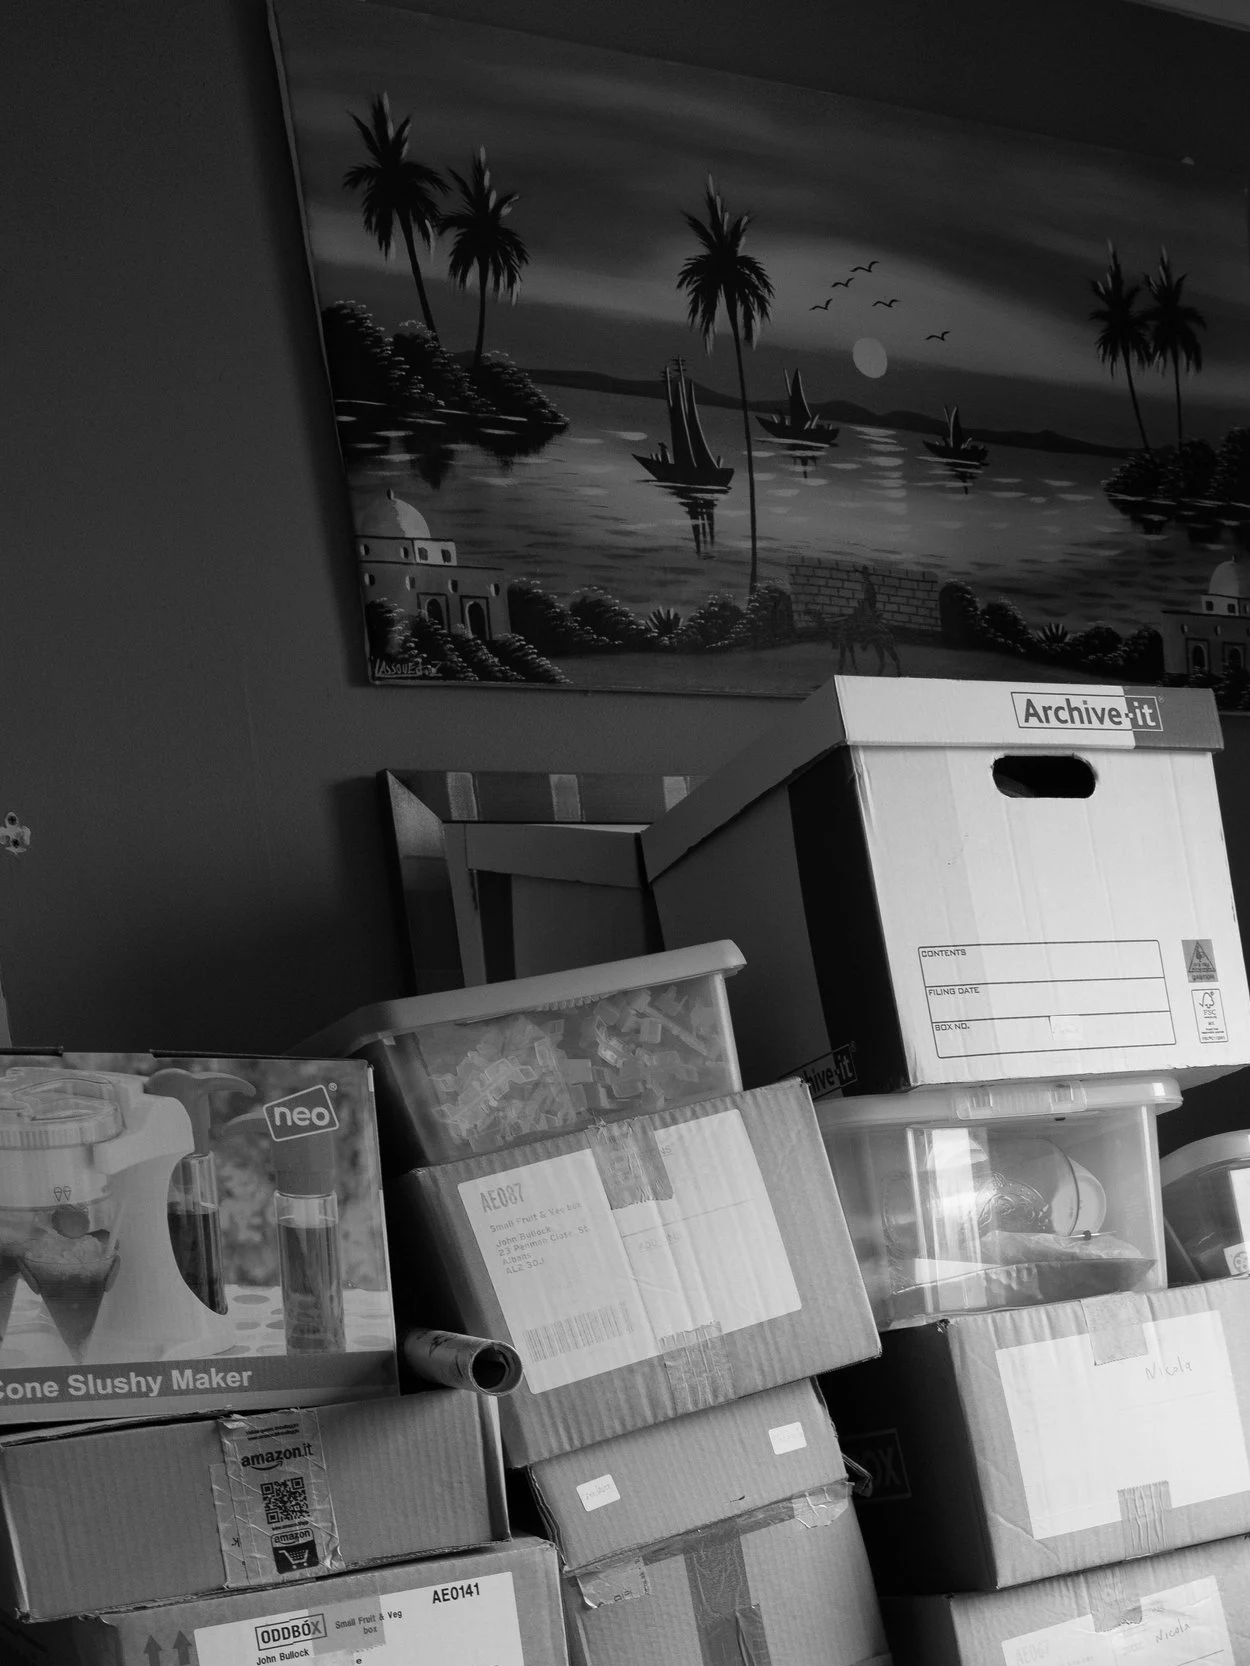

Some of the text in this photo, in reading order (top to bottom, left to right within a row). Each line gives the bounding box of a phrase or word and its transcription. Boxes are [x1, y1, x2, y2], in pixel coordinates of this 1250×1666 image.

[1024, 698, 1156, 726] Archive-it
[921, 949, 967, 958] CONTENTS
[928, 986, 980, 996] FILING DATE
[935, 1022, 971, 1031] BOX NO.
[273, 1106, 330, 1126] neo
[480, 1183, 525, 1213] AE087
[67, 1372, 163, 1397] Slushy
[171, 1368, 252, 1390] Maker
[240, 1442, 314, 1468] amazon.it
[274, 1530, 311, 1544] amazon
[432, 1582, 480, 1604] AE0141
[335, 1610, 403, 1630] Small Fruit & Veg
[363, 1625, 378, 1635] box
[1155, 1616, 1191, 1643] Nicola
[256, 1648, 310, 1666] John Bullock
